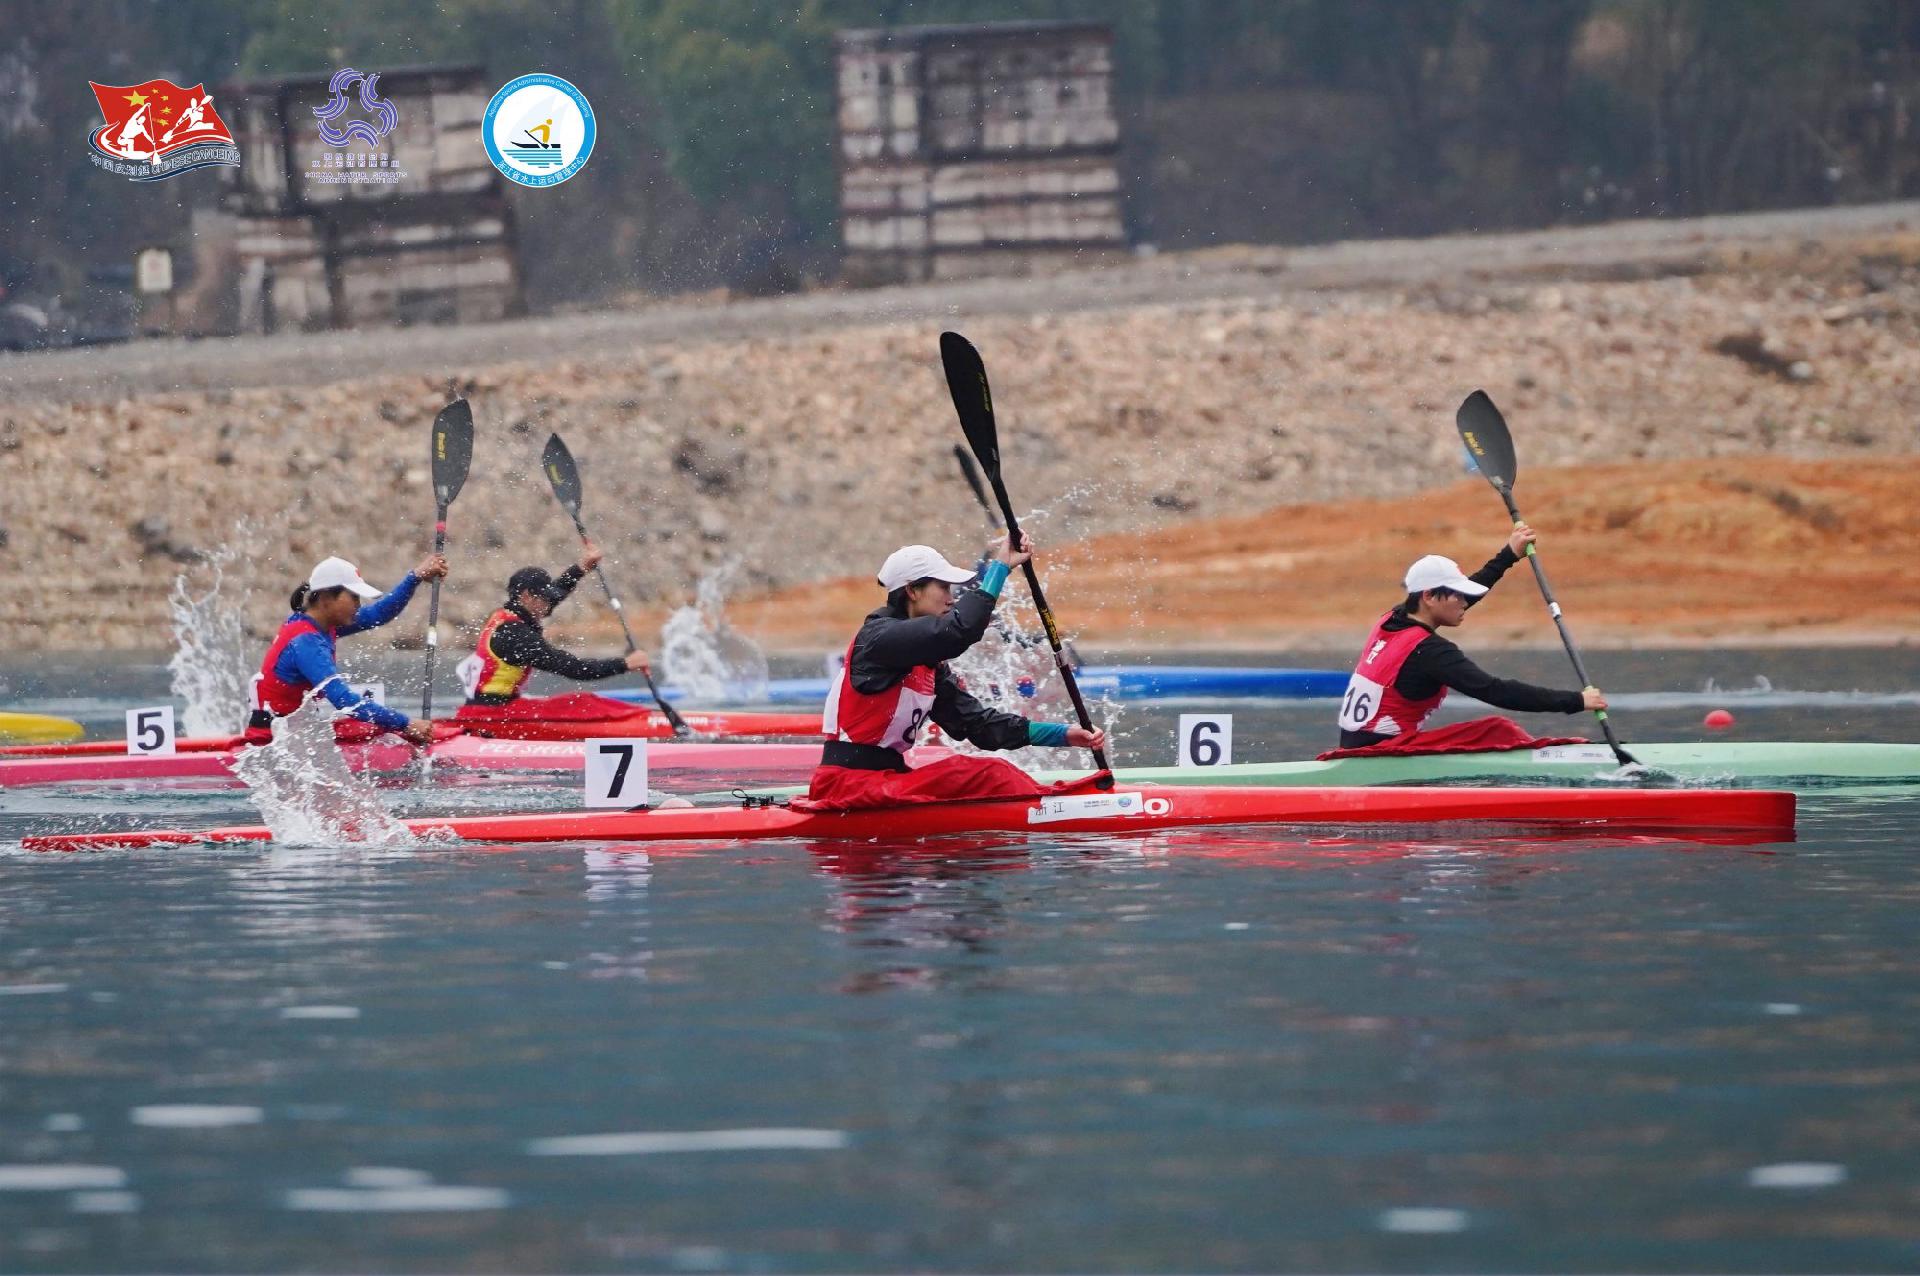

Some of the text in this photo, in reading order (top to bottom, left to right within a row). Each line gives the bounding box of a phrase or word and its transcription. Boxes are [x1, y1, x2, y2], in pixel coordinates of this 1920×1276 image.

[1343, 687, 1372, 723] 16
[136, 711, 165, 751] 5
[1190, 721, 1222, 766] 6
[600, 745, 633, 798] 7
